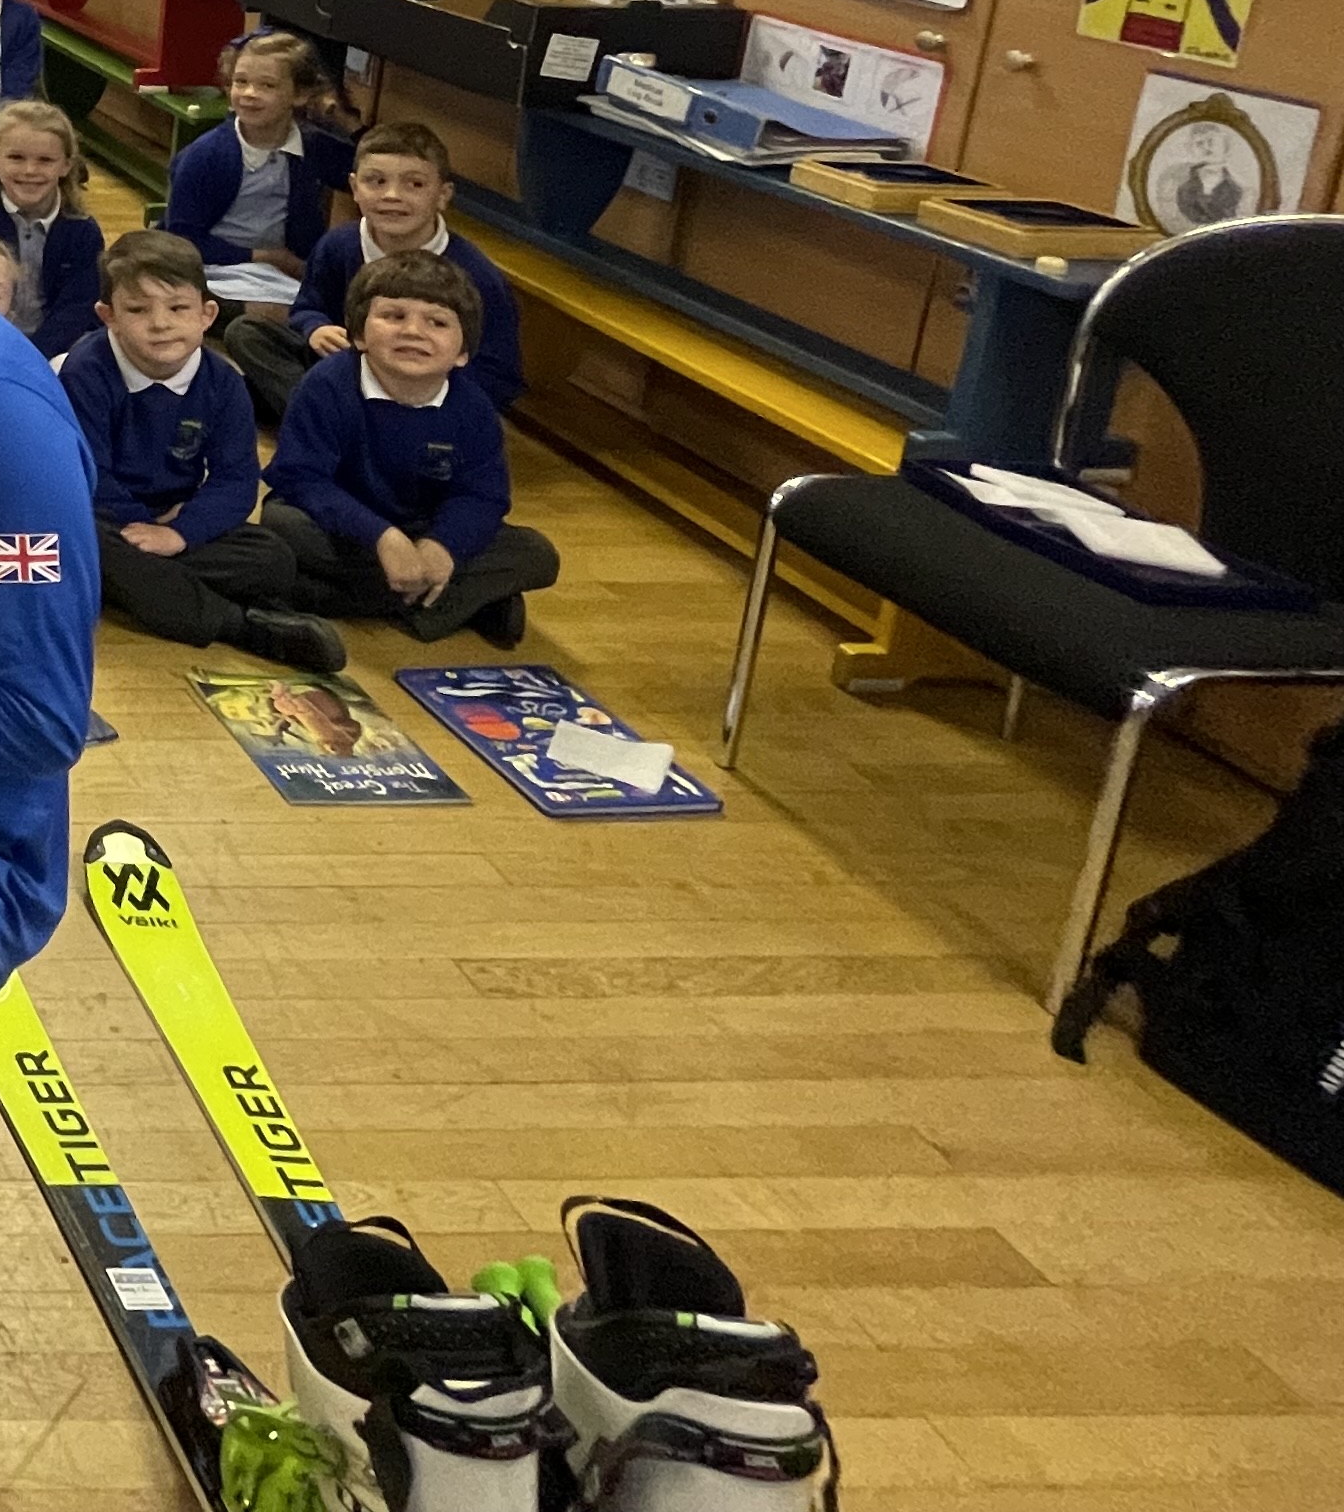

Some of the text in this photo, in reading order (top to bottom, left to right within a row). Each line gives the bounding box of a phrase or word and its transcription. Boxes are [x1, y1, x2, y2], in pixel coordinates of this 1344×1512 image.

[277, 761, 438, 782] Monster Hunt
[315, 777, 387, 796] Great
